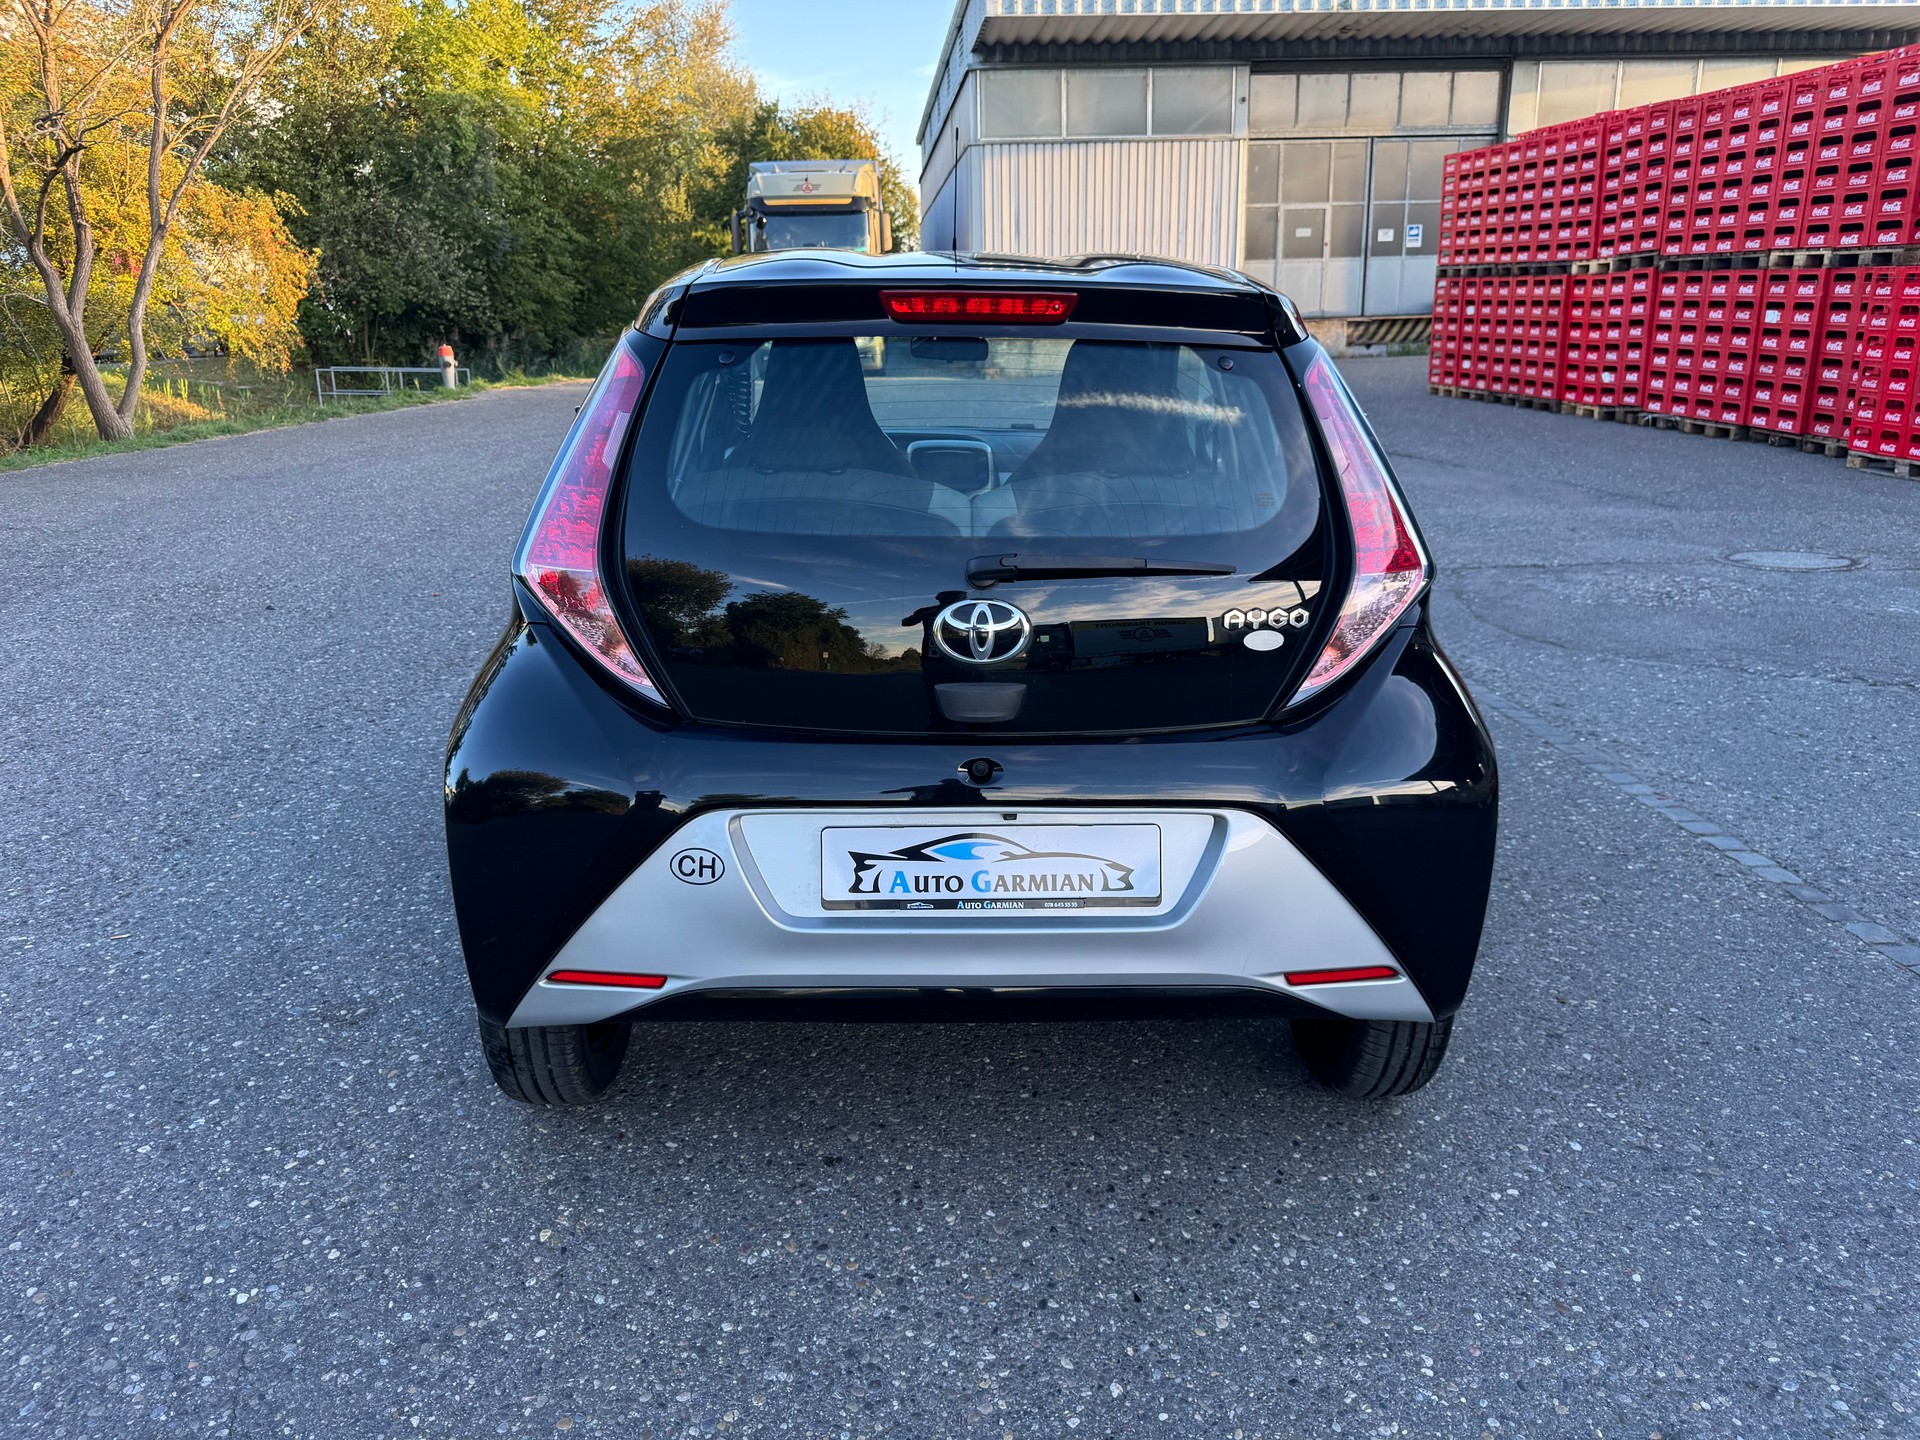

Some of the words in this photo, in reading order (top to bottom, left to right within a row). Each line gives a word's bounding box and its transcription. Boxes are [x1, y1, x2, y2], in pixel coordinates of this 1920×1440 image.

[1223, 607, 1310, 630] AYGO
[678, 855, 716, 879] CH
[971, 870, 1094, 893] GARMIAN
